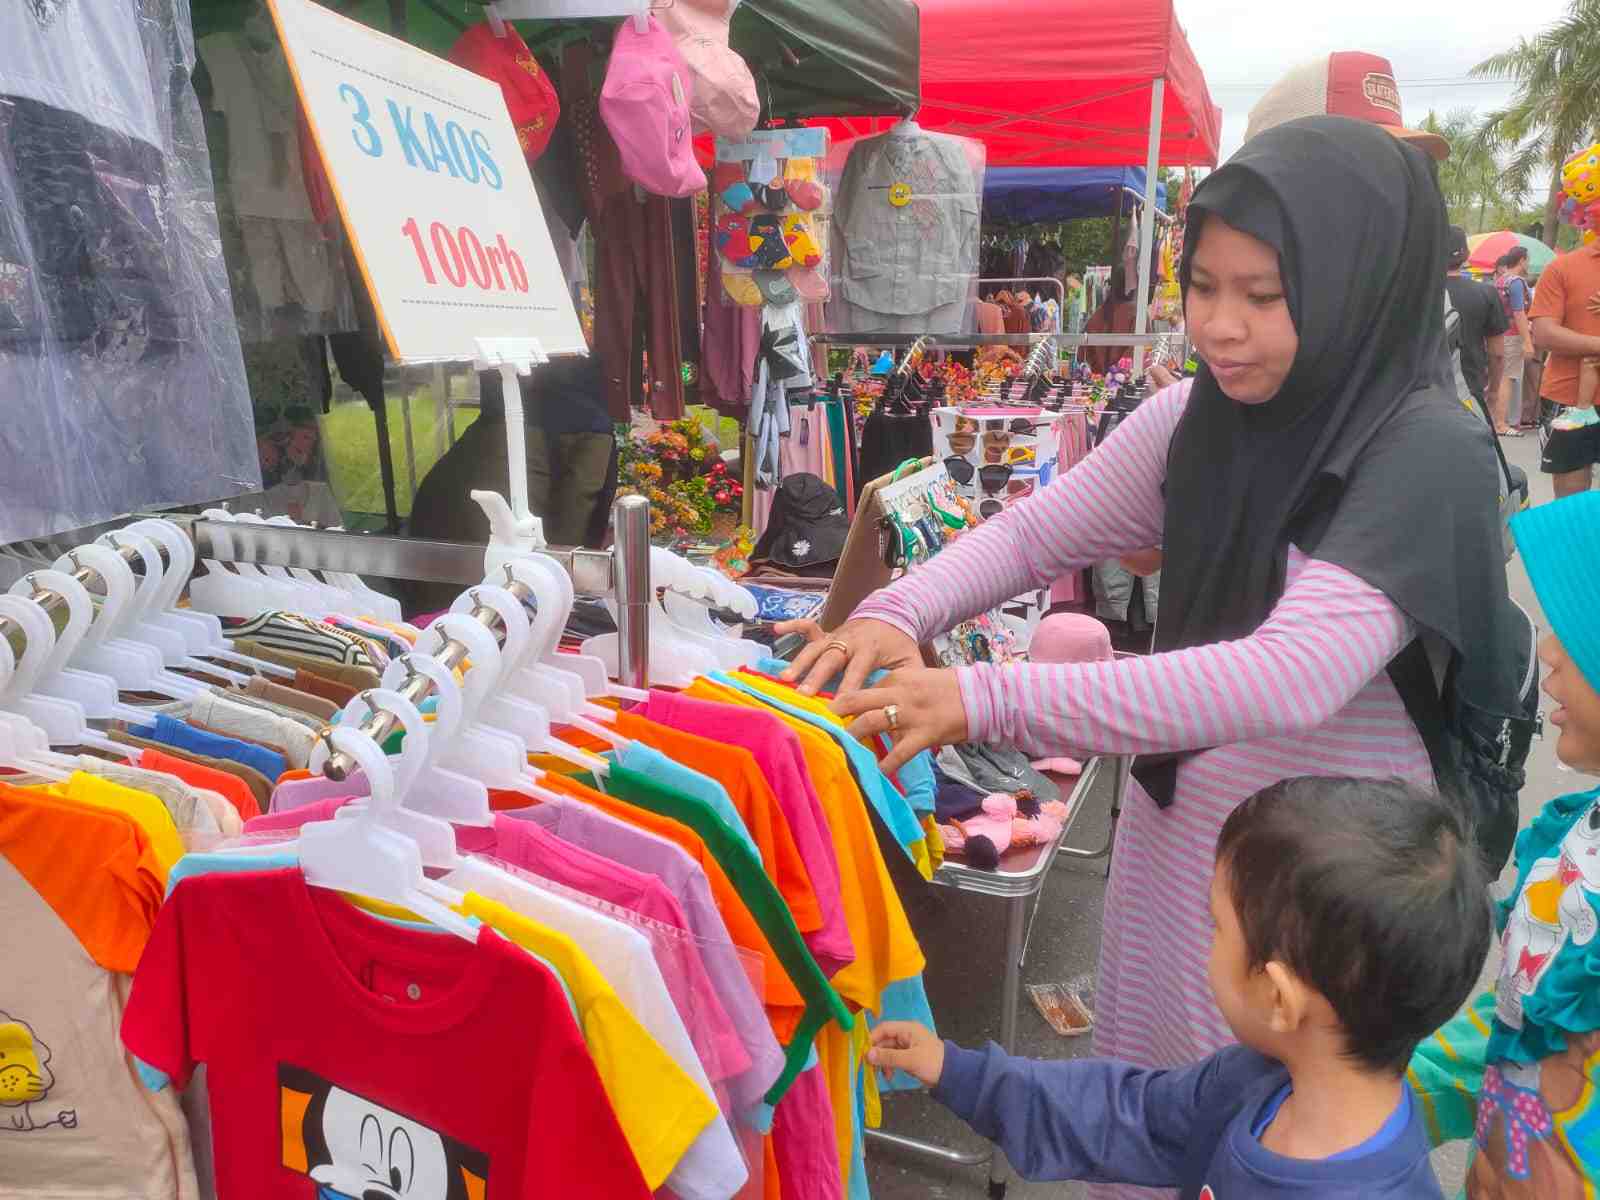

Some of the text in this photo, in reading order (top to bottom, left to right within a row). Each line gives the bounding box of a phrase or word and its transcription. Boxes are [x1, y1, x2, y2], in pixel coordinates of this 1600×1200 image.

[338, 82, 383, 157] 3
[386, 98, 503, 190] KAOS
[401, 217, 529, 293] 100rb
